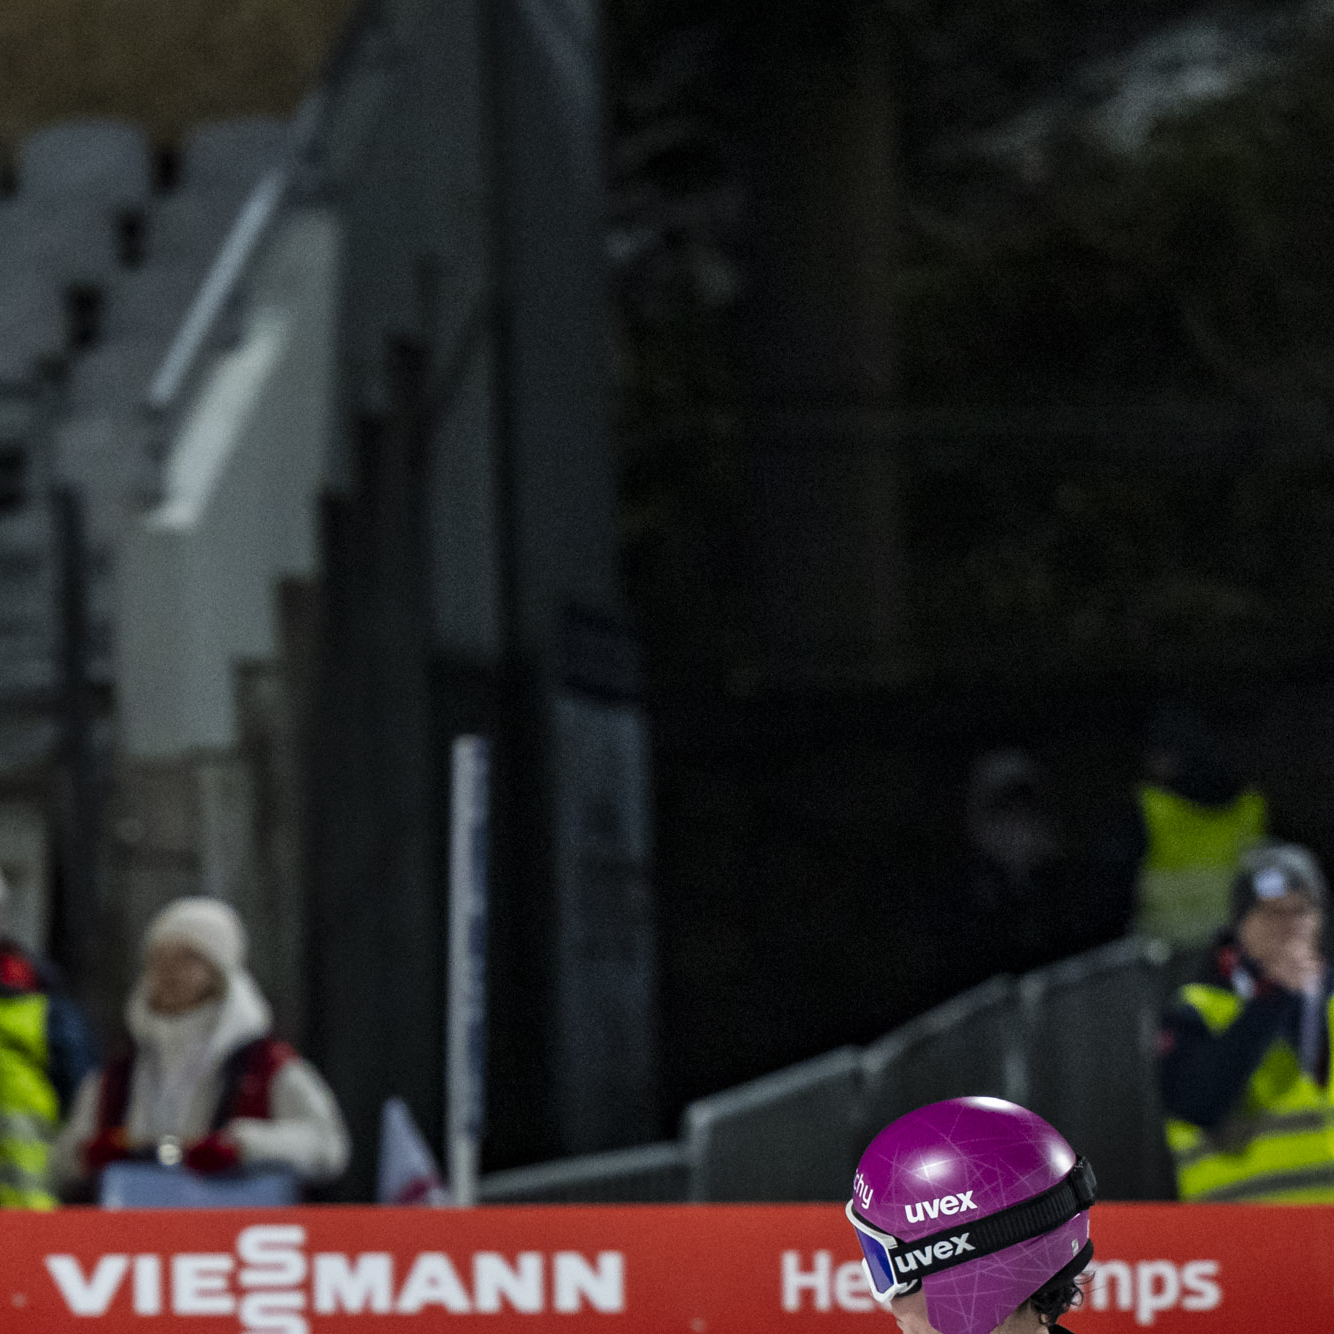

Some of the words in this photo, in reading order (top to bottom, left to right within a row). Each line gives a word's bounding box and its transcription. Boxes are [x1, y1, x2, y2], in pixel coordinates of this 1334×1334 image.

[853, 1168, 874, 1209] chy
[905, 1190, 978, 1224] uvex
[895, 1233, 976, 1273] uvex
[780, 1249, 870, 1314] He
[1070, 1259, 1223, 1328] mps
